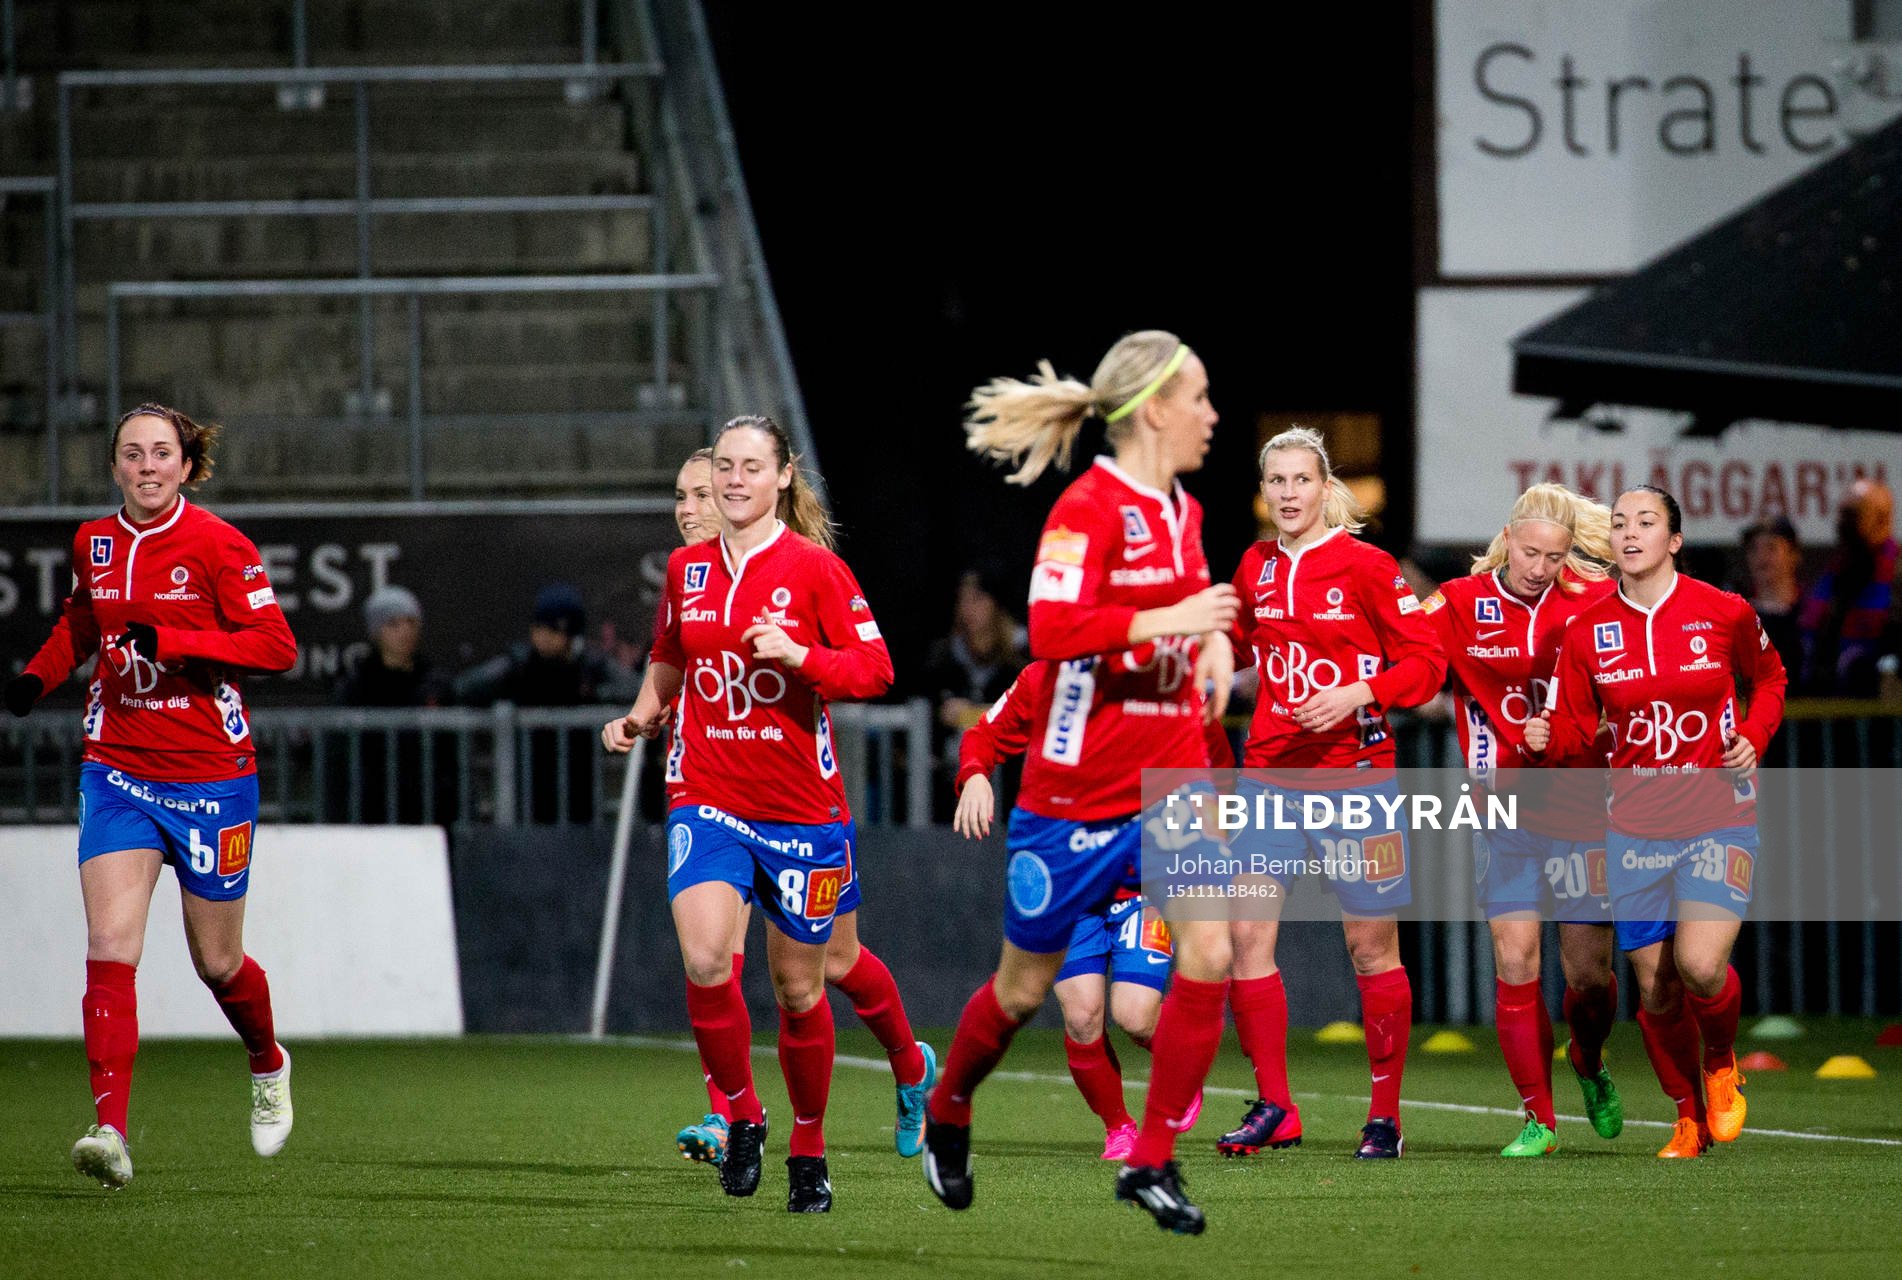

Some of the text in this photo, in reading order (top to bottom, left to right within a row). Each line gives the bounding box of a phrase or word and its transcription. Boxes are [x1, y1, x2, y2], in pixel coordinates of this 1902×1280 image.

[91, 586, 119, 599] adium
[681, 607, 716, 622] adium
[1266, 641, 1342, 703] ÖBO
[1466, 645, 1519, 658] stadium
[694, 650, 786, 721] ÖBO
[1594, 668, 1644, 684] stadium
[167, 696, 190, 709] dig
[706, 725, 783, 741] Hem för dig
[1626, 701, 1708, 760] ÖBO
[106, 769, 220, 814] Örebroar'n
[1320, 838, 1363, 883] 10
[1544, 852, 1587, 899] 20
[778, 869, 804, 915] 8
[1118, 910, 1139, 949] 4
